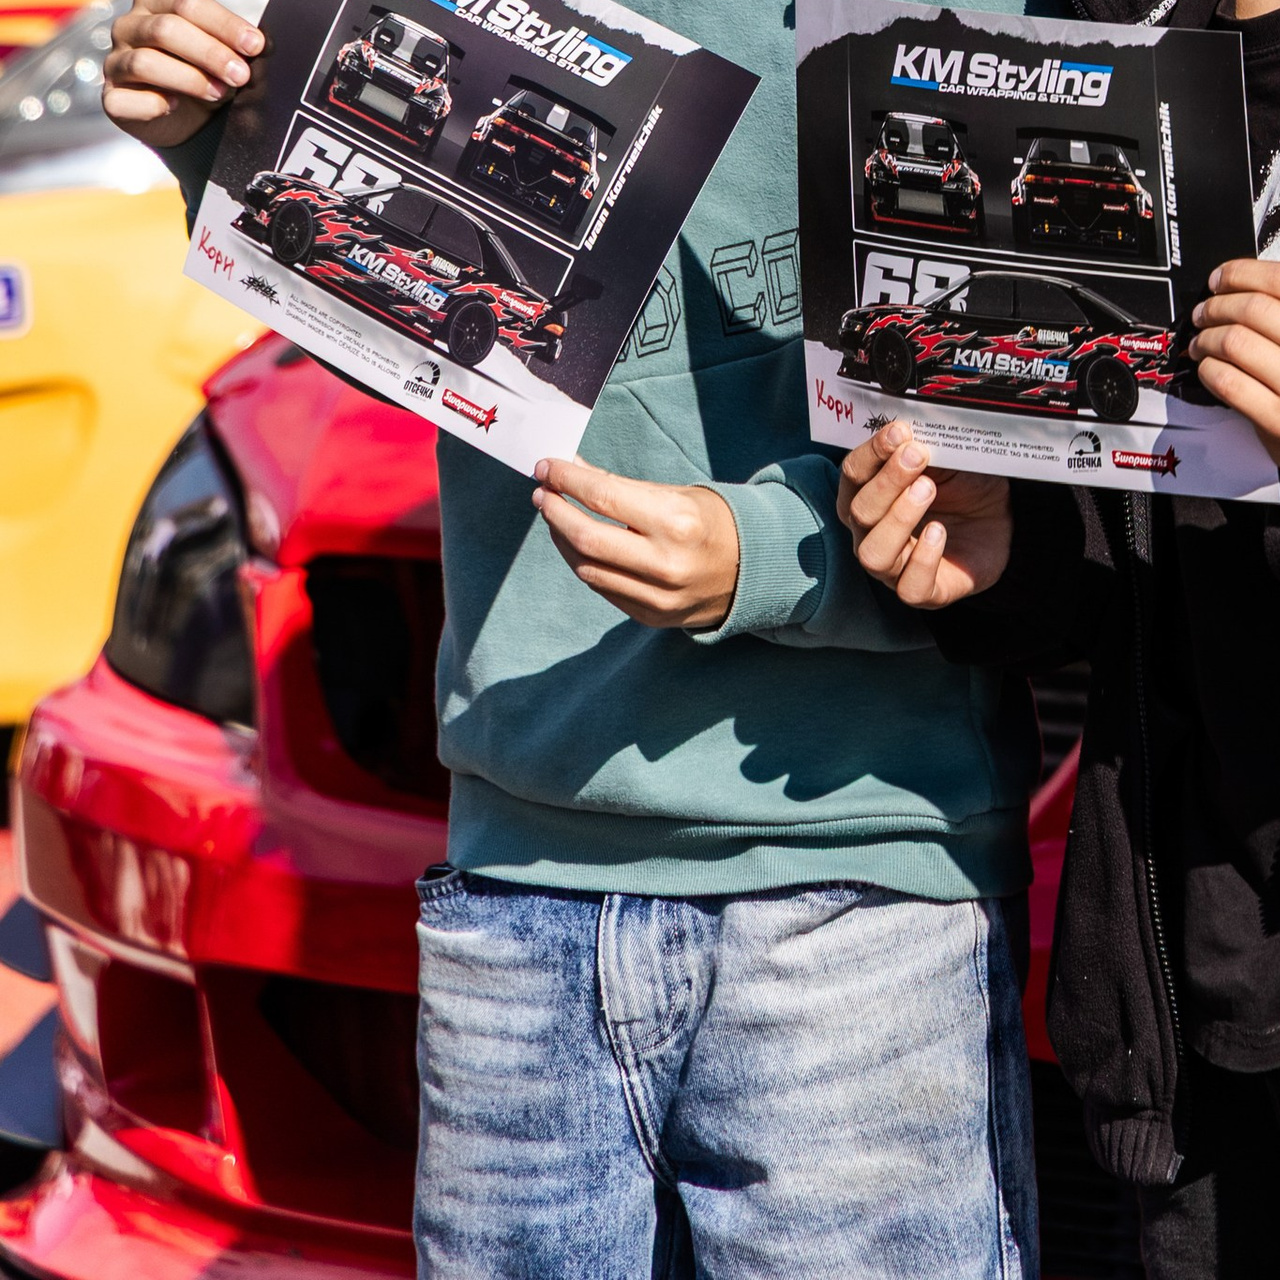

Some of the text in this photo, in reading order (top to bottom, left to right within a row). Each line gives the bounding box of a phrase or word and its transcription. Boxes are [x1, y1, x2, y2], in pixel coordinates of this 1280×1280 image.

[454, 7, 482, 27] CAR
[481, 21, 551, 60] WRAPPING
[547, 54, 558, 65] &
[892, 44, 1112, 107] KM Styling
[938, 83, 967, 95] CAR
[966, 86, 1036, 102] WRAPPING
[1037, 93, 1049, 103] &
[584, 207, 610, 251] Ivan
[1169, 219, 1182, 267] Ivan
[347, 243, 446, 312] KM Styling
[953, 347, 1070, 383] KM Styling
[403, 380, 434, 400] ОТСЕЧКА
[443, 390, 489, 422] Swapworks
[912, 420, 923, 428] ALL
[1067, 456, 1102, 469] ОТСЕЧКА
[1114, 451, 1167, 467] Swapworks
